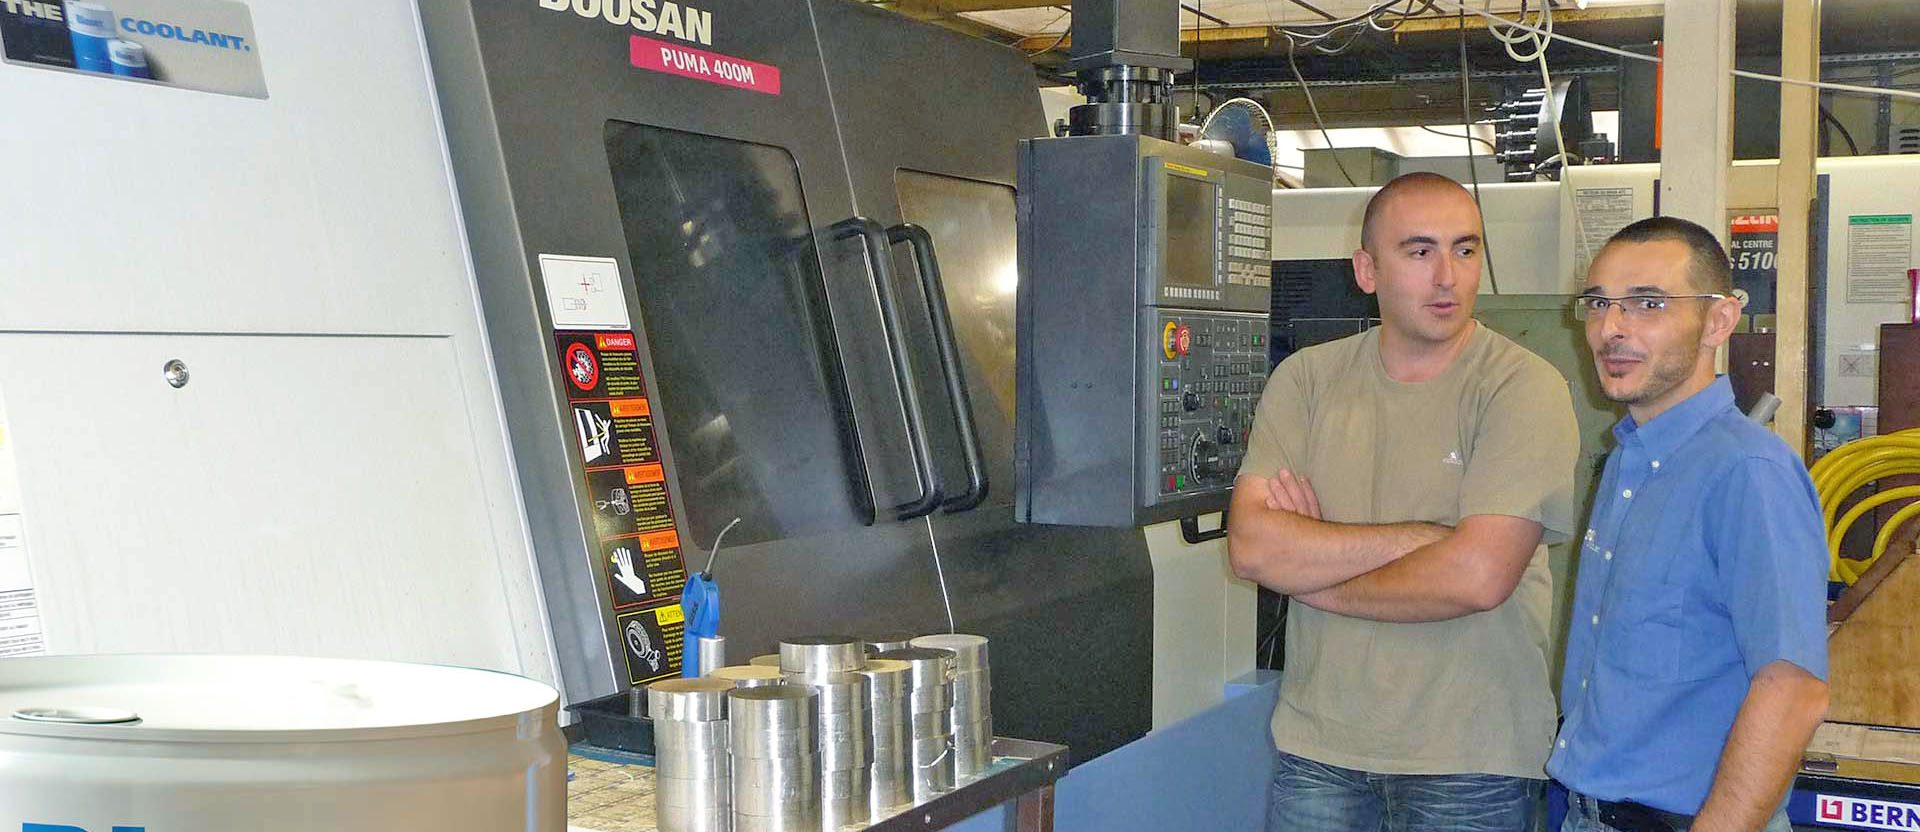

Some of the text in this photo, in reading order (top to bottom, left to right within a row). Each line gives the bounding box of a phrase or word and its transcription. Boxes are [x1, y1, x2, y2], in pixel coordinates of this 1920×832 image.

[1, 0, 64, 21] THE
[120, 17, 251, 51] COOLANT.
[660, 47, 755, 85] PUMA 400M
[1743, 240, 1774, 249] CENTRE
[605, 338, 632, 346] DANGER
[1852, 802, 1920, 828] BERN
